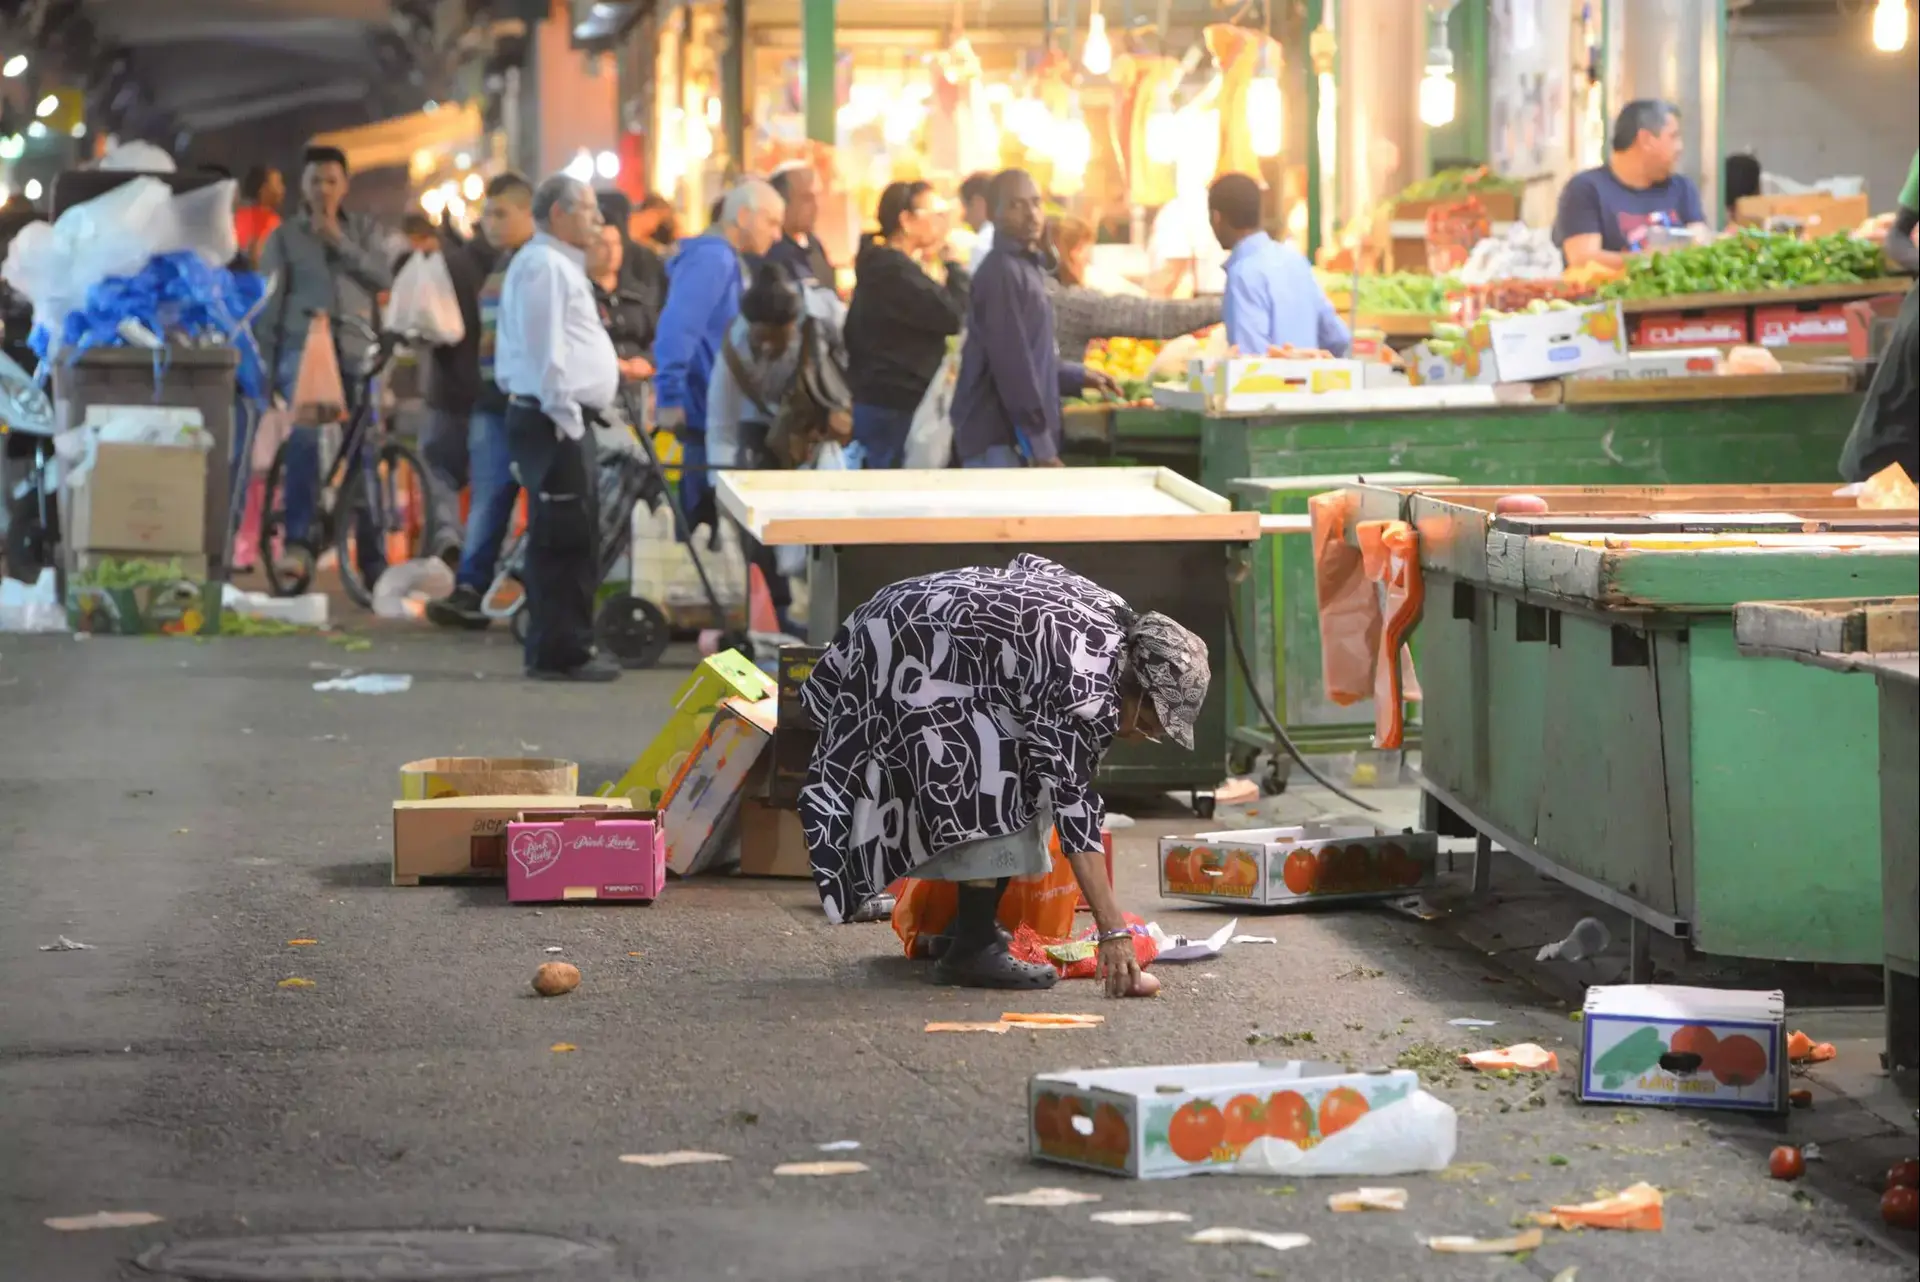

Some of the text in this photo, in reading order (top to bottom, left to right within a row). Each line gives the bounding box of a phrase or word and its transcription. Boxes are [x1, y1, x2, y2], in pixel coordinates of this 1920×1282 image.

[523, 839, 548, 857] Pink
[572, 834, 639, 850] Pink Lady
[526, 847, 551, 864] Lady
